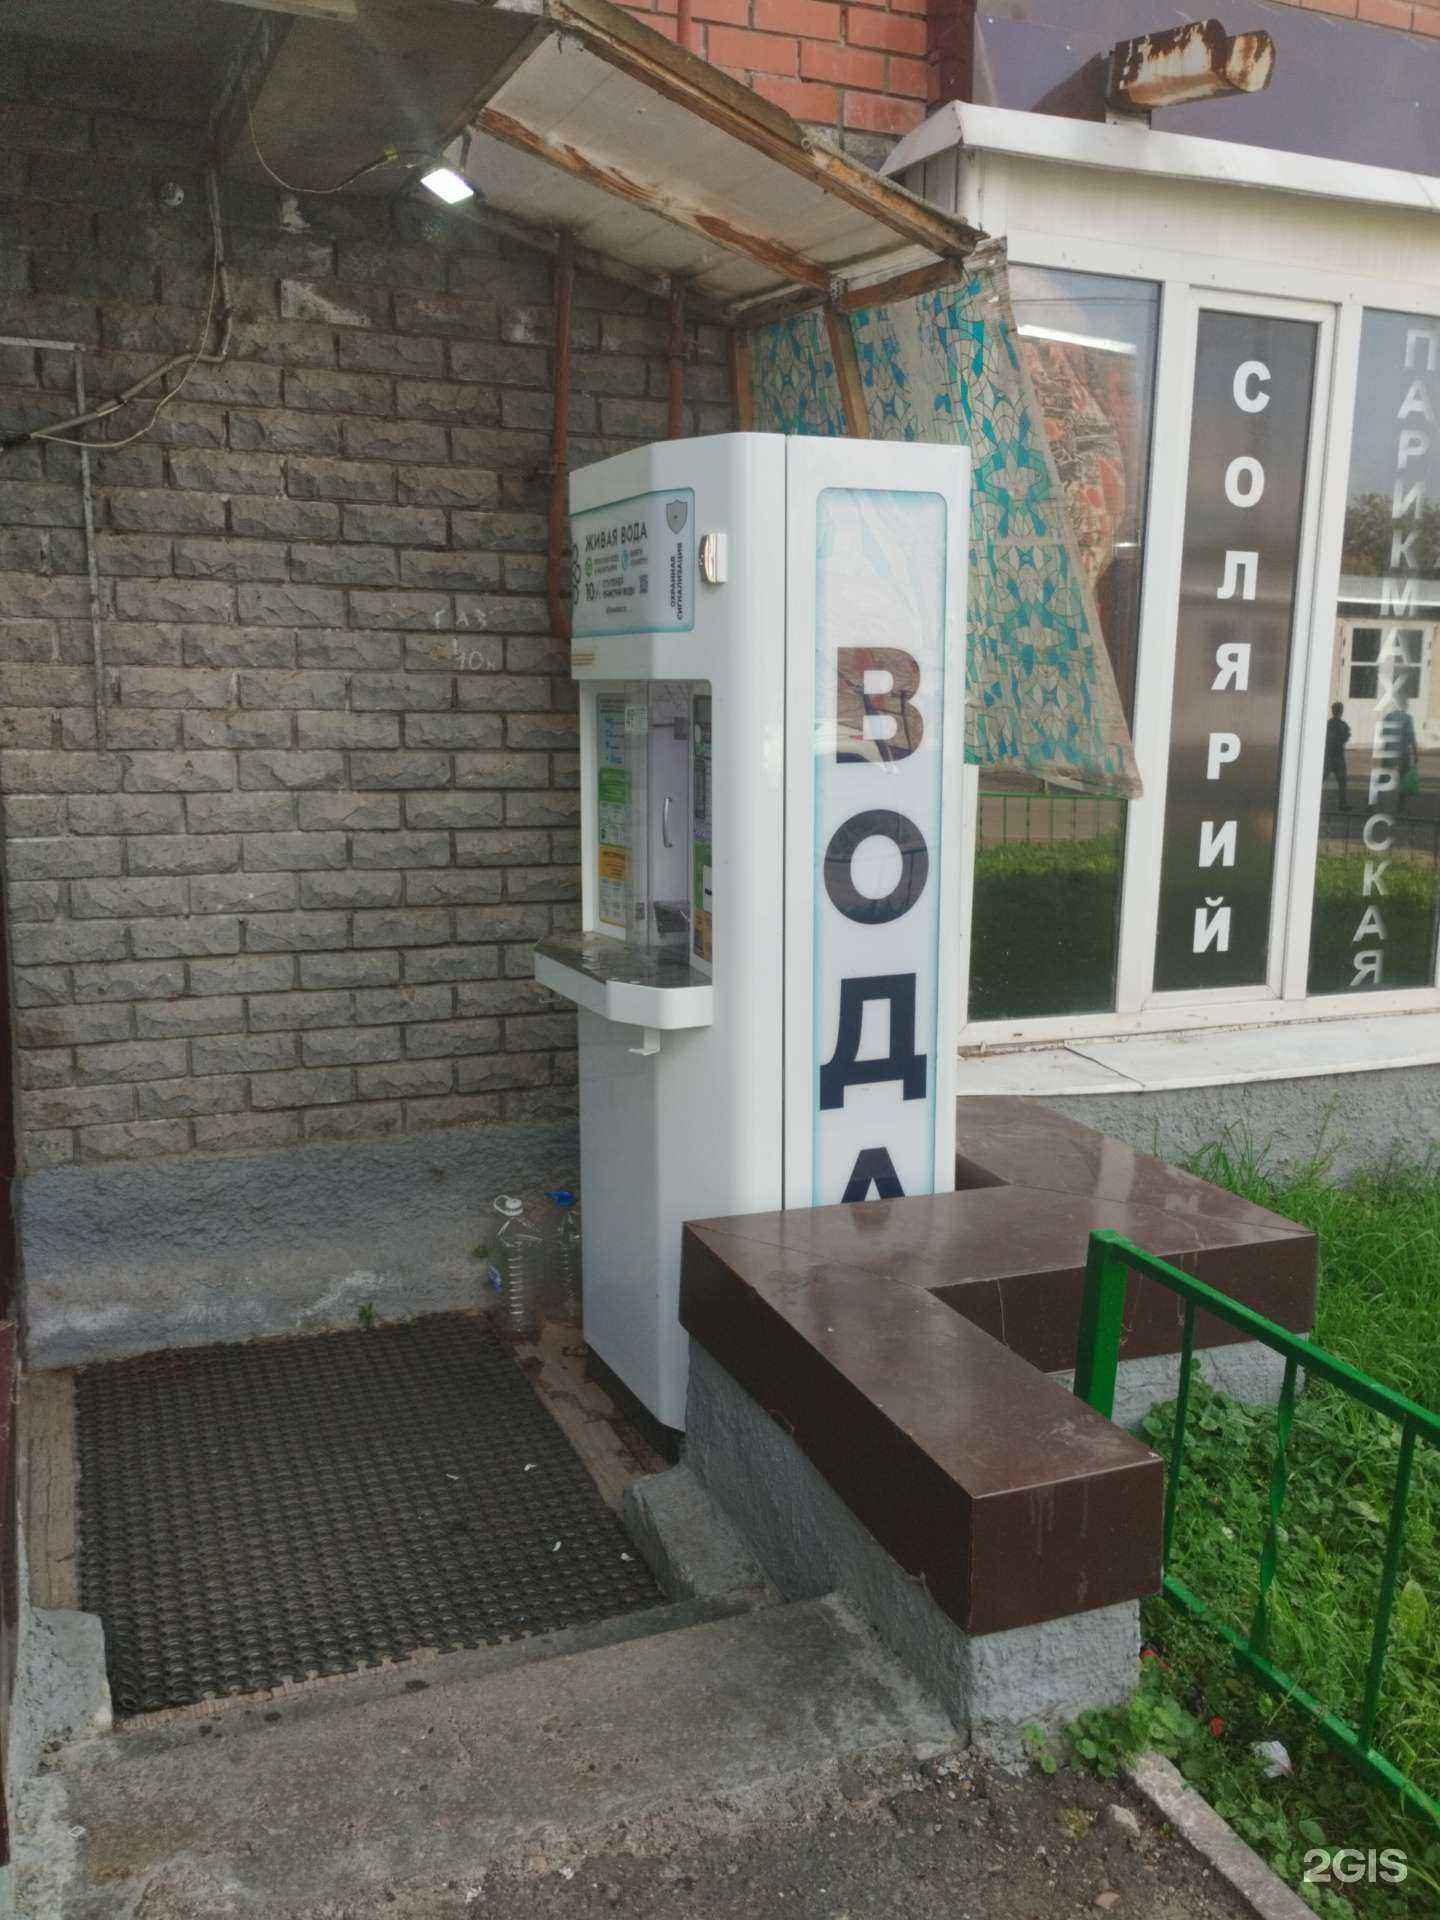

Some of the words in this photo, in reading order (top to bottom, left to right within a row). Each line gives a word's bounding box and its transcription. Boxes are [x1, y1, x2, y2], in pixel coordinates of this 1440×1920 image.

[586, 530, 617, 551] ЖИВАЯ
[621, 523, 647, 543] ВОДА
[1192, 359, 1273, 953] СОЛЯРИЙ
[1351, 328, 1438, 988] ПАРИКМАХЕРСКАЯ
